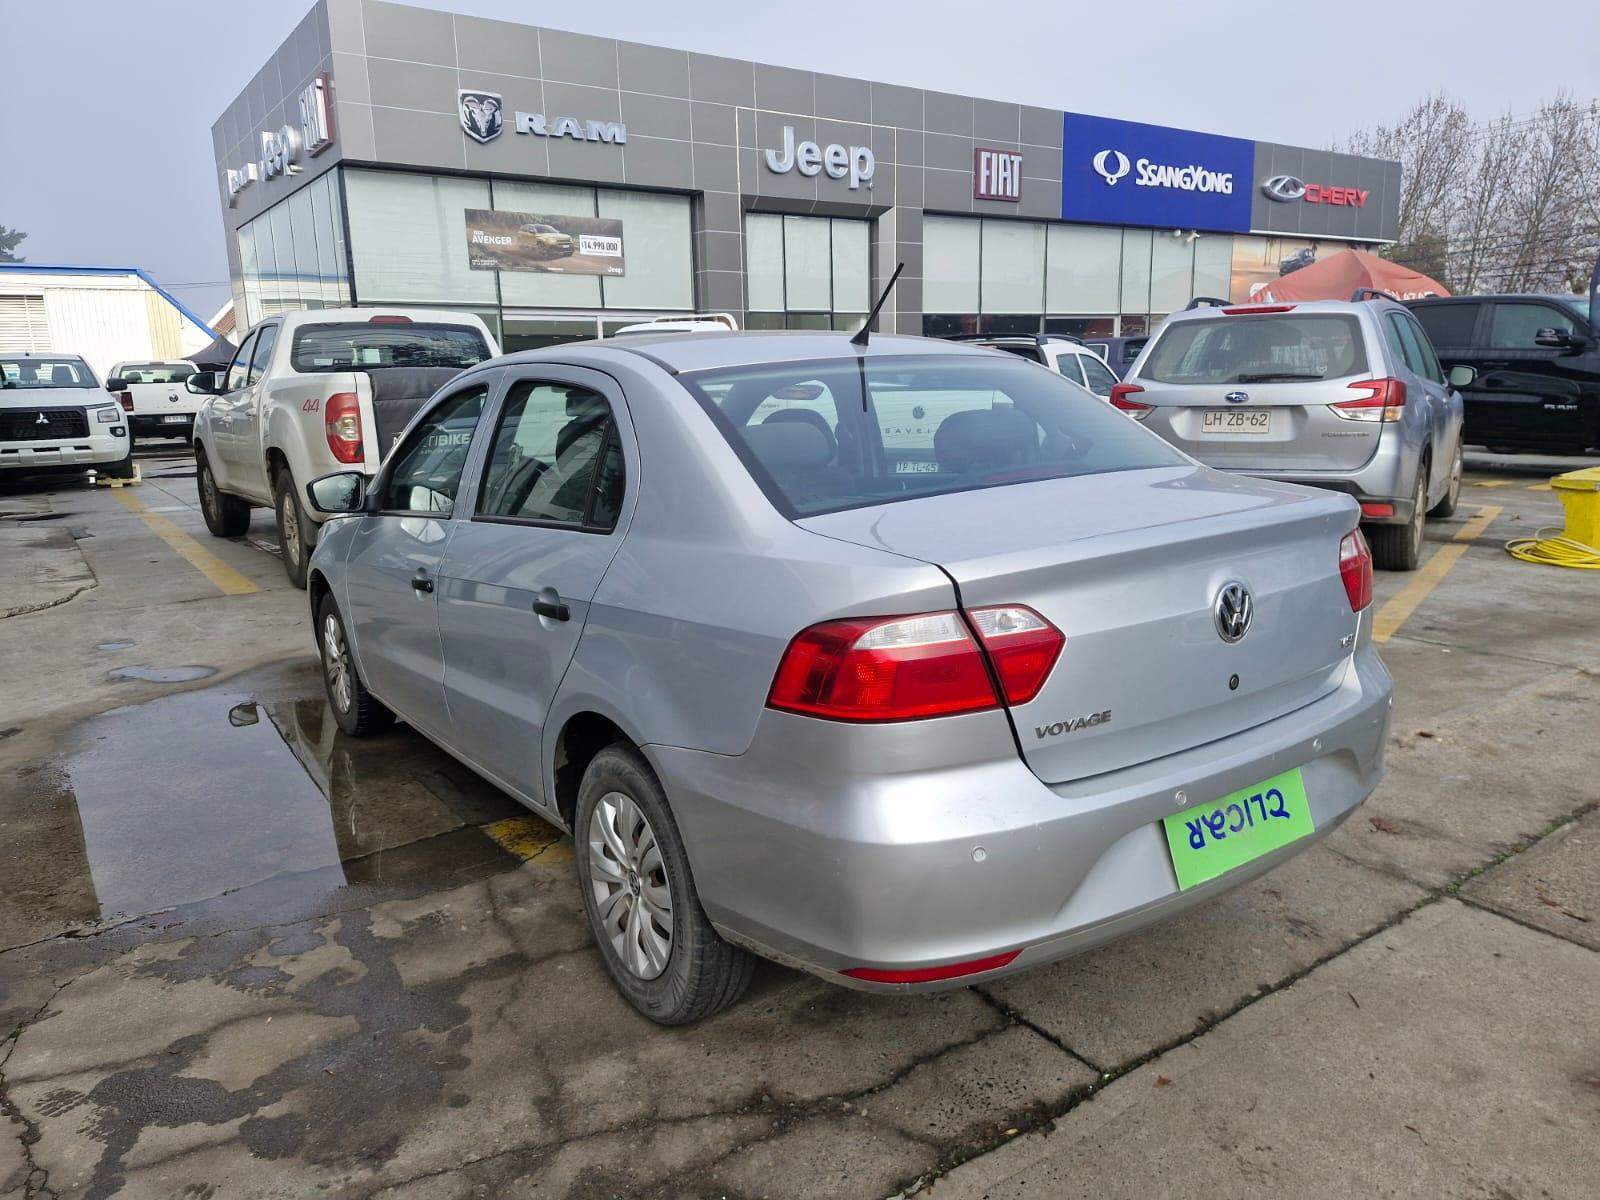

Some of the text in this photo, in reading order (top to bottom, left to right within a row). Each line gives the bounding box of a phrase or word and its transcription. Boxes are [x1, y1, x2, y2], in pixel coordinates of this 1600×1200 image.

[514, 111, 626, 144] RAM
[765, 126, 875, 190] Jeep
[980, 151, 1022, 197] FIAT
[1304, 183, 1369, 208] CHERY
[472, 235, 513, 245] AVENGER
[1034, 709, 1112, 739] VOYAGE
